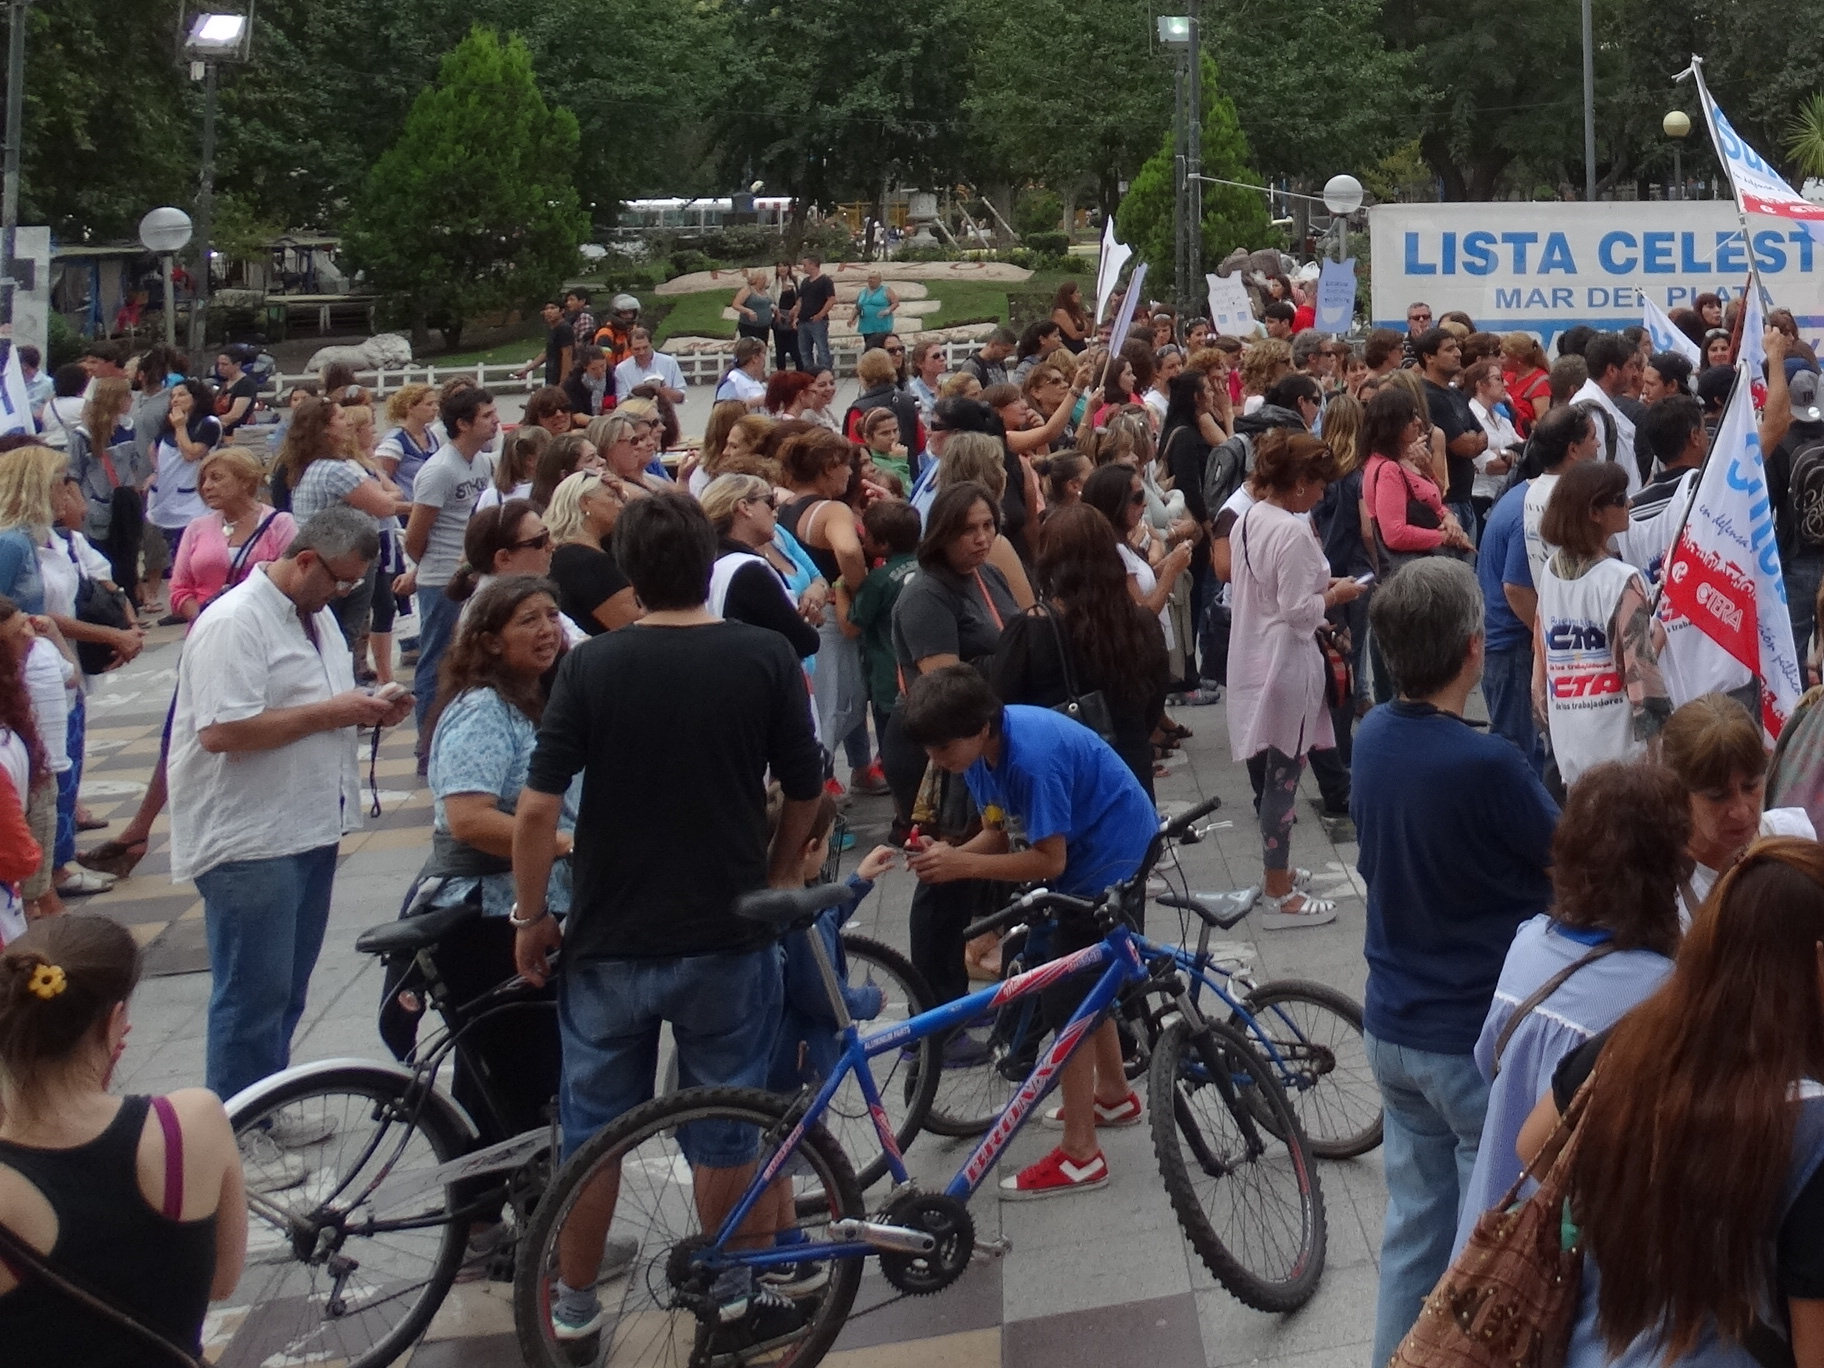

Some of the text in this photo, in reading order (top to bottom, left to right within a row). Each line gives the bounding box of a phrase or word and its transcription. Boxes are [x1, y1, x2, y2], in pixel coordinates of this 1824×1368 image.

[1404, 231, 1578, 275] LISTA
[1495, 287, 1575, 309] MAR
[1587, 287, 1646, 309] DEL
[1695, 581, 1745, 633] CTERA
[1549, 624, 1606, 651] CTA
[1554, 672, 1624, 698] CTA
[1571, 696, 1624, 710] trabajadores
